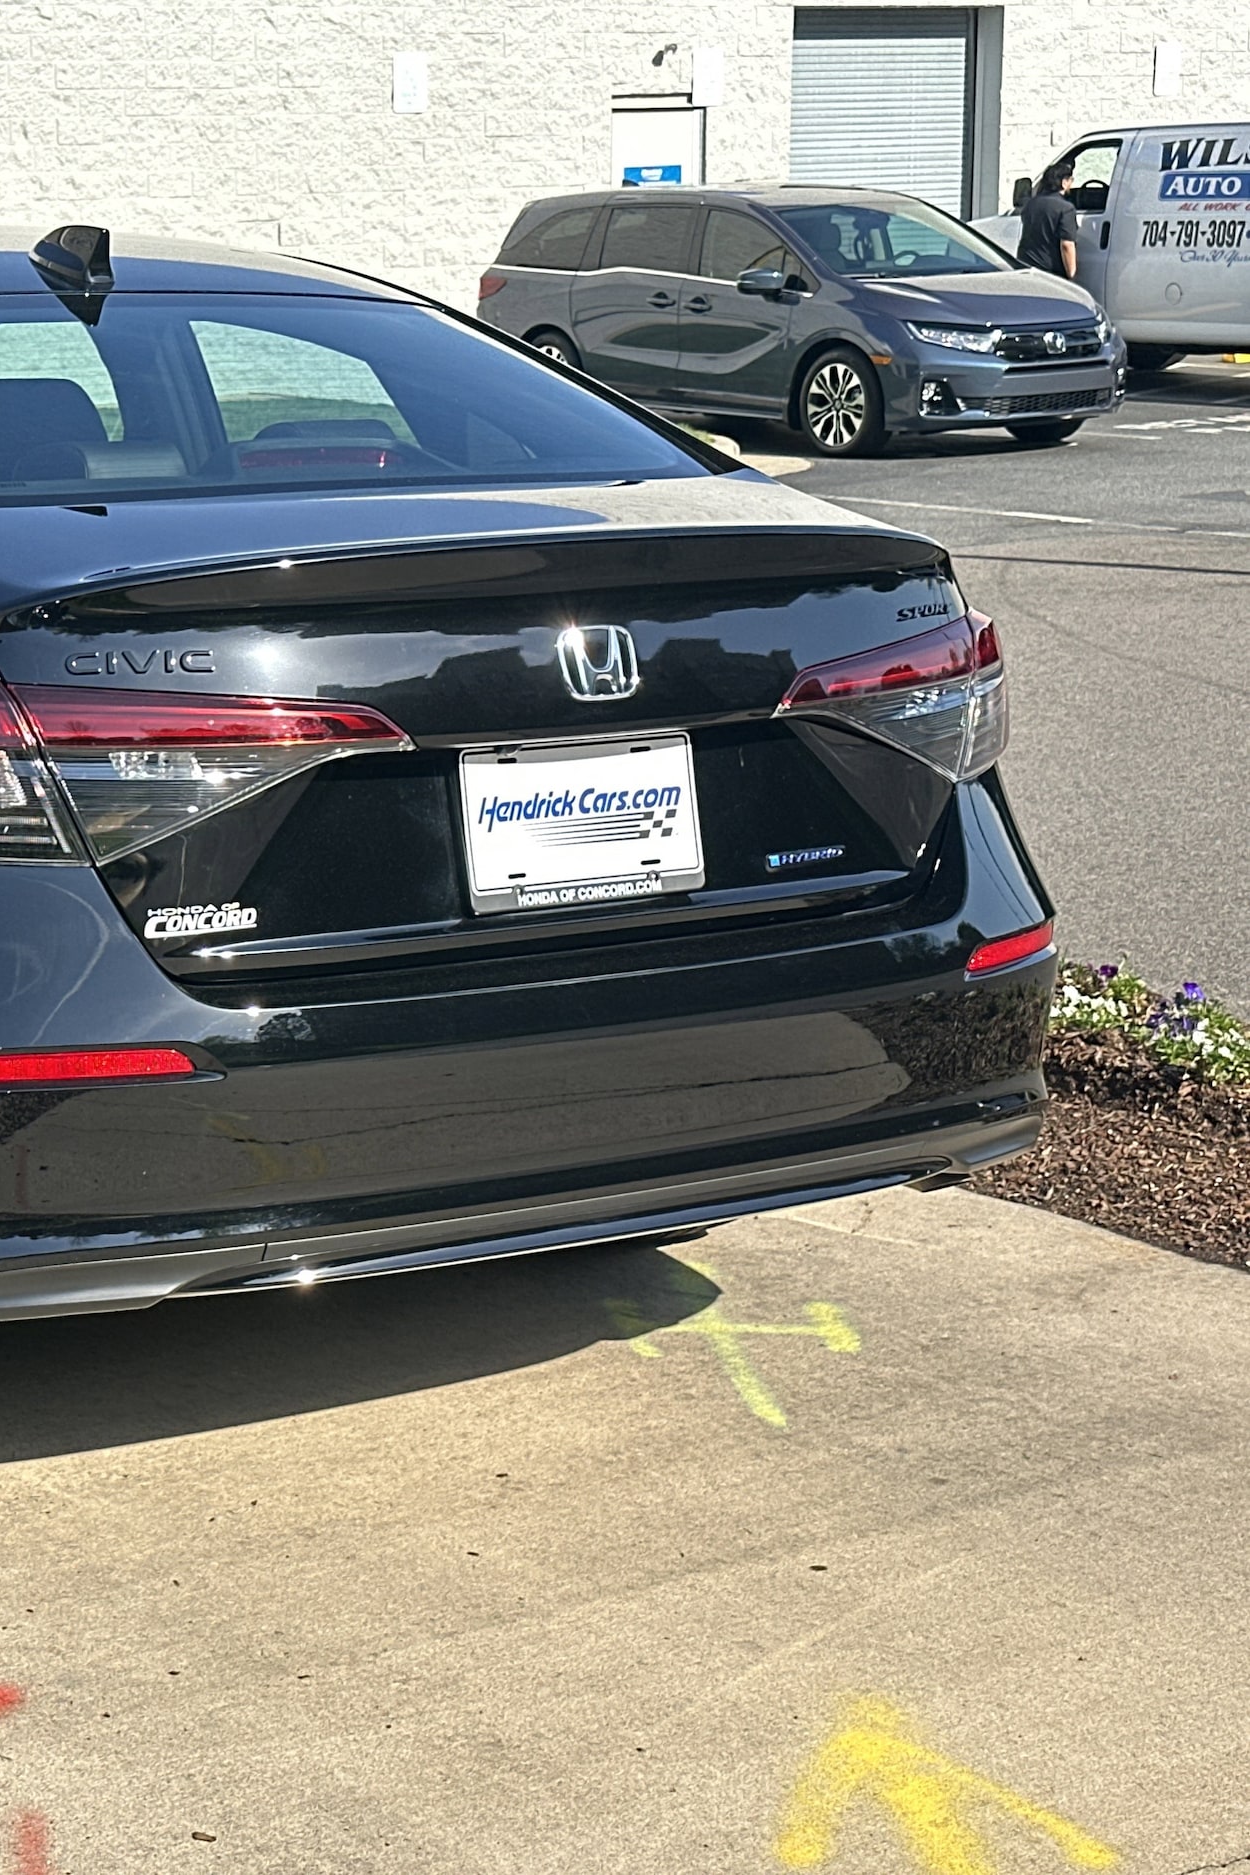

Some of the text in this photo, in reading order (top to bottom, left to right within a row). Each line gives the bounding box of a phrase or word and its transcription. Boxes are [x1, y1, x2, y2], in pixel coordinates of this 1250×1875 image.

[1165, 176, 1242, 196] AUTO
[1178, 203, 1199, 211] ALL
[1203, 203, 1241, 211] WORK
[64, 650, 217, 676] CIVIC
[517, 880, 662, 907] HONDA OF CONCORD.COM
[147, 903, 218, 917] HONDA
[144, 907, 257, 939] CONCORD
